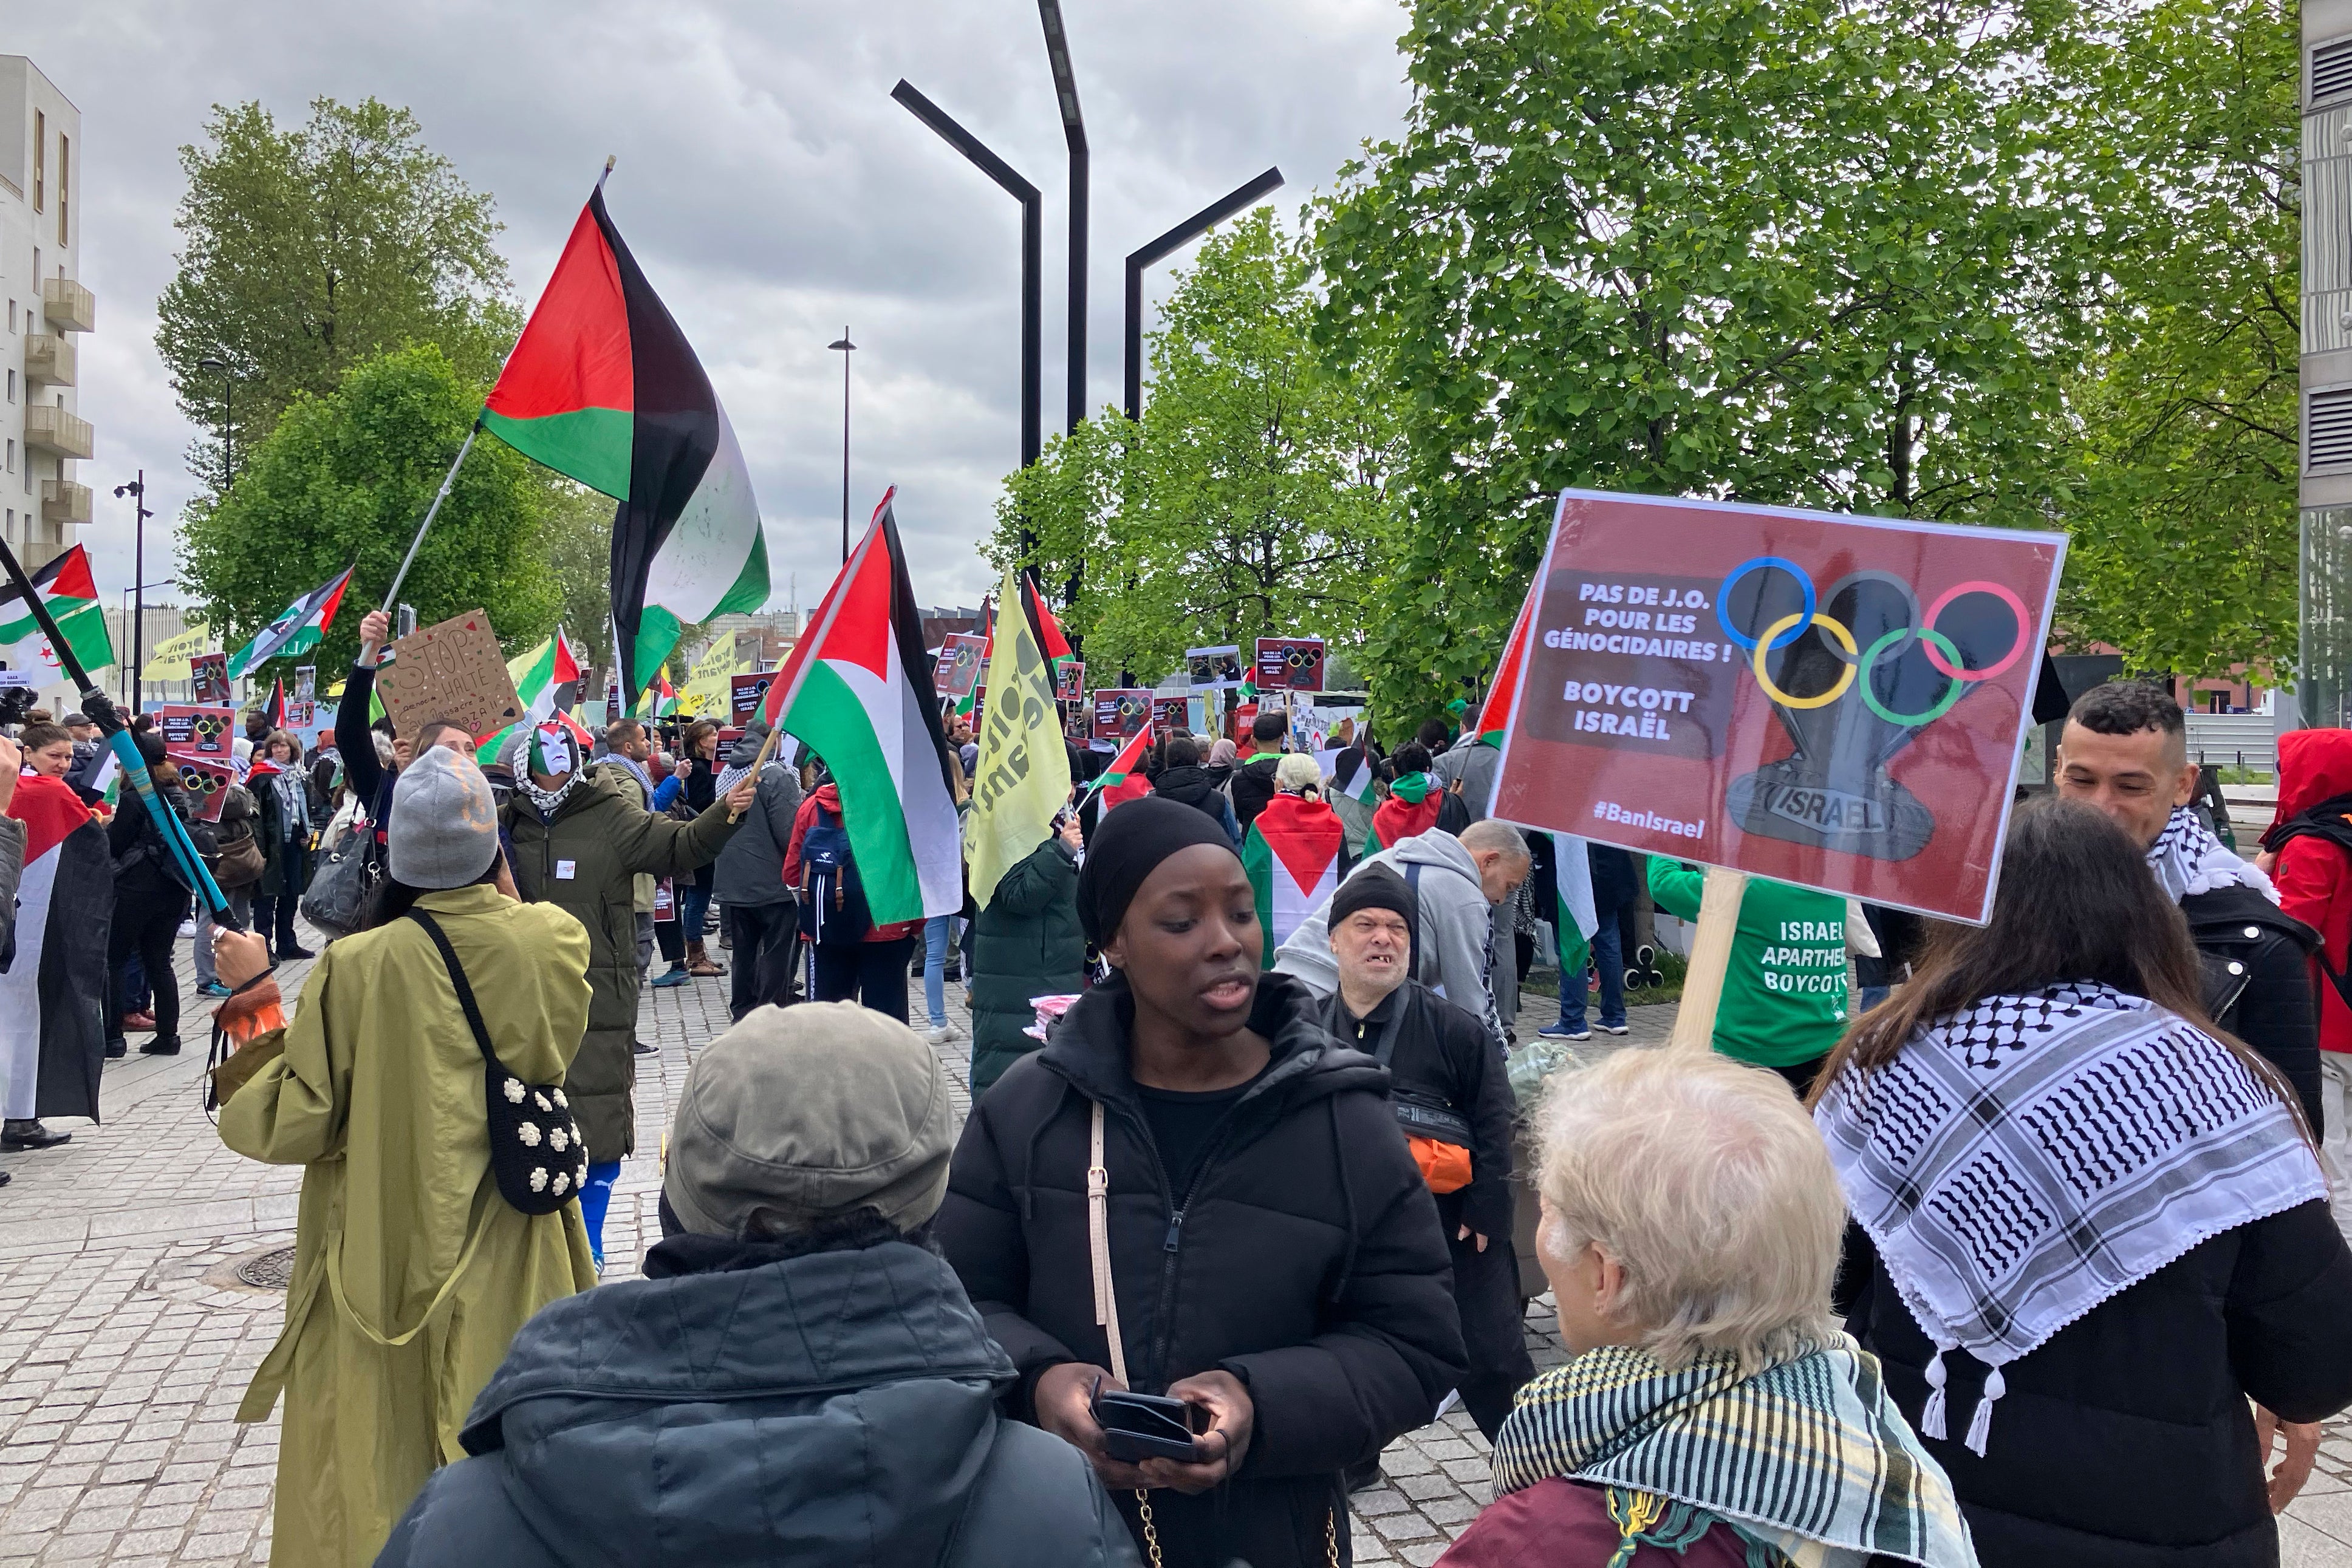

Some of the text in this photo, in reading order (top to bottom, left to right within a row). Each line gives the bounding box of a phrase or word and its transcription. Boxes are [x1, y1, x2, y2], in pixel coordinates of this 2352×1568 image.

[1579, 582, 1711, 610] PAS DE J.O.
[1584, 608, 1697, 634] POUR LES
[395, 630, 468, 690] STOP
[1544, 627, 1732, 663] GÉNOCIDAIRES !
[441, 667, 489, 701] HALTE
[1563, 680, 1695, 713] BOYCOTT
[460, 707, 487, 725] aZA
[1574, 710, 1671, 741] ISRAËL
[1593, 800, 1706, 840] #BanIsrael
[1777, 788, 1882, 829] ISRAEL
[1780, 921, 1844, 941] ISRAEL
